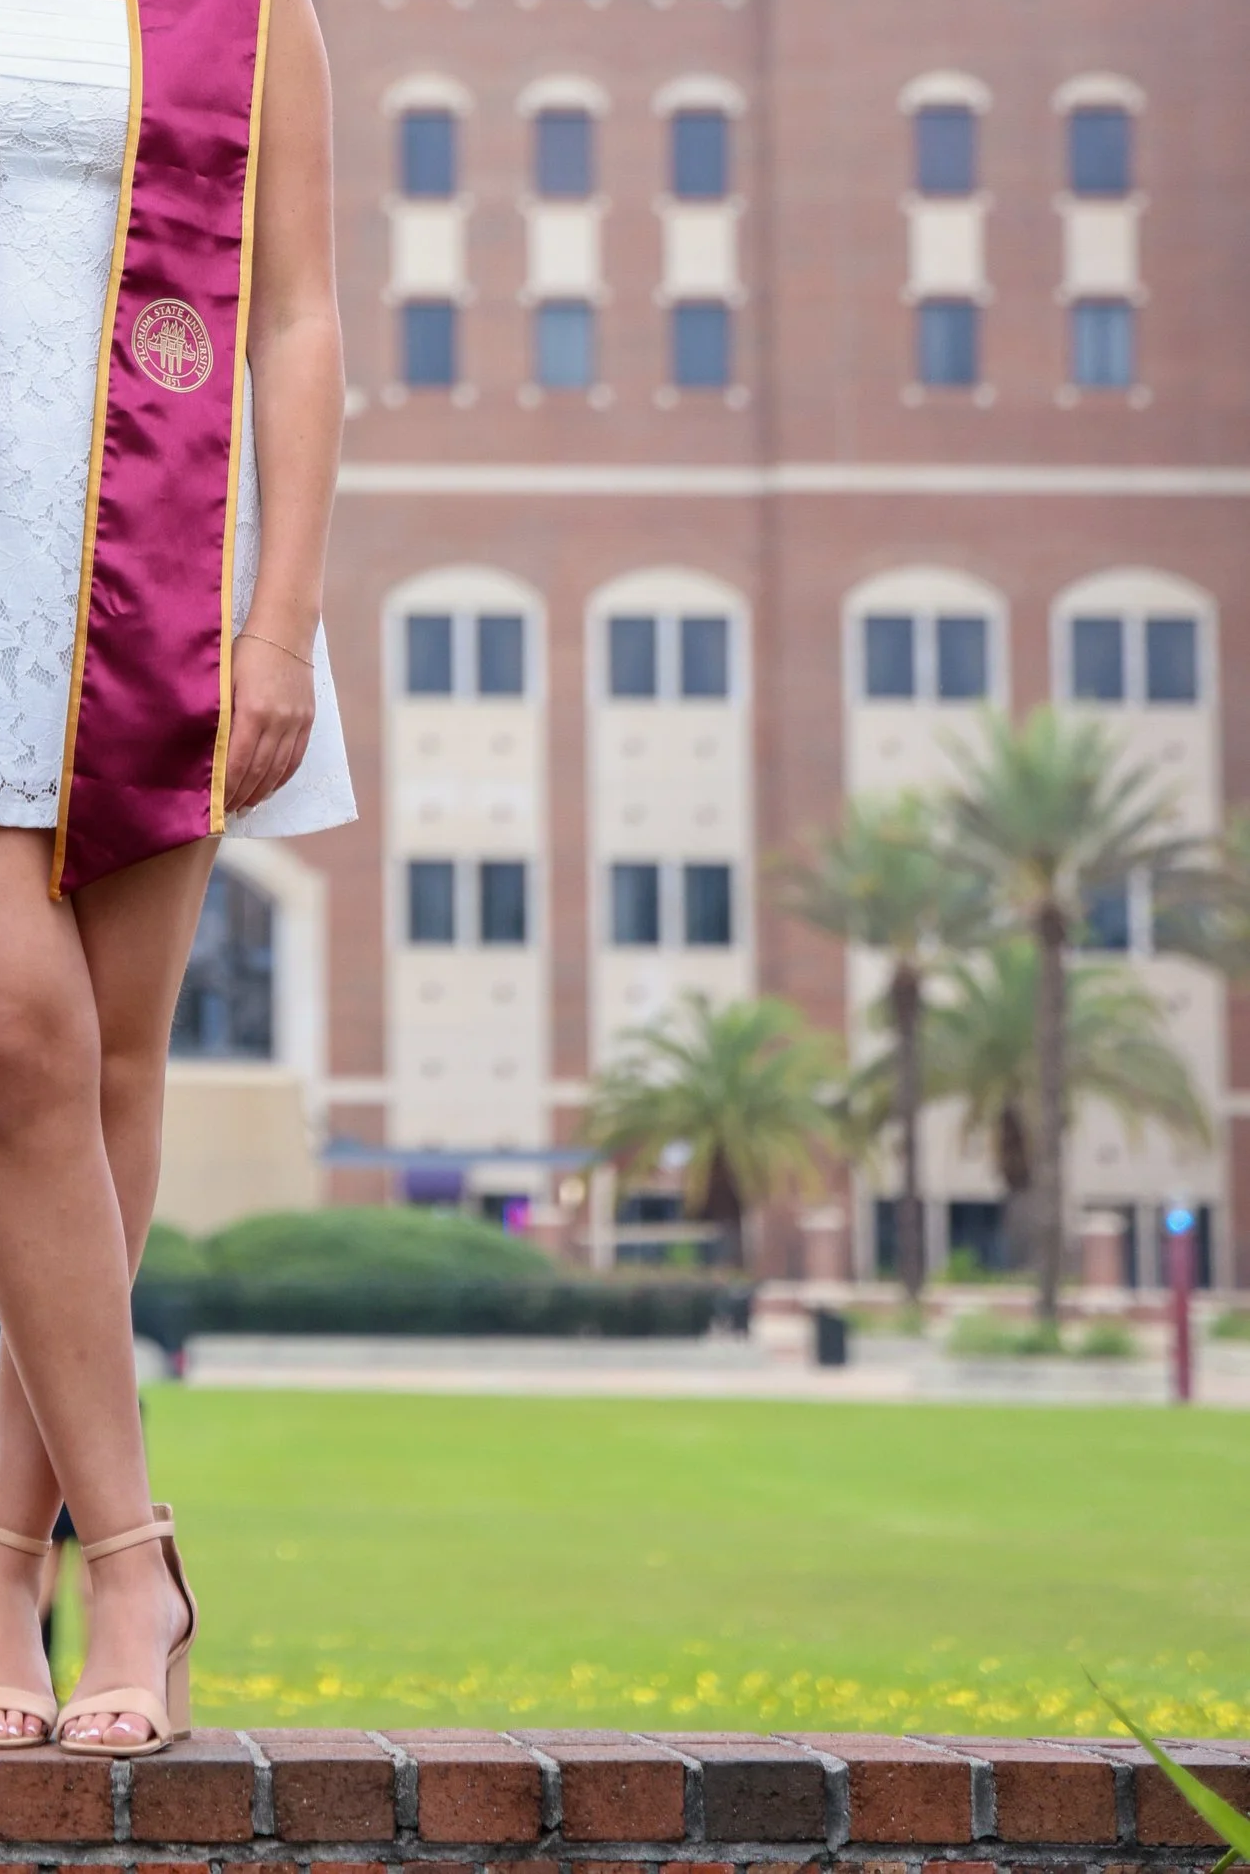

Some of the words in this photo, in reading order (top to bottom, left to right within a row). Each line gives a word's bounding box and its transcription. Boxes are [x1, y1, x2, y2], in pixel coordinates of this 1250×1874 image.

[136, 314, 154, 363] FLORIDA
[154, 305, 185, 317] STATE
[185, 314, 208, 378] UNIVERSITY
[162, 374, 181, 387] 1851
